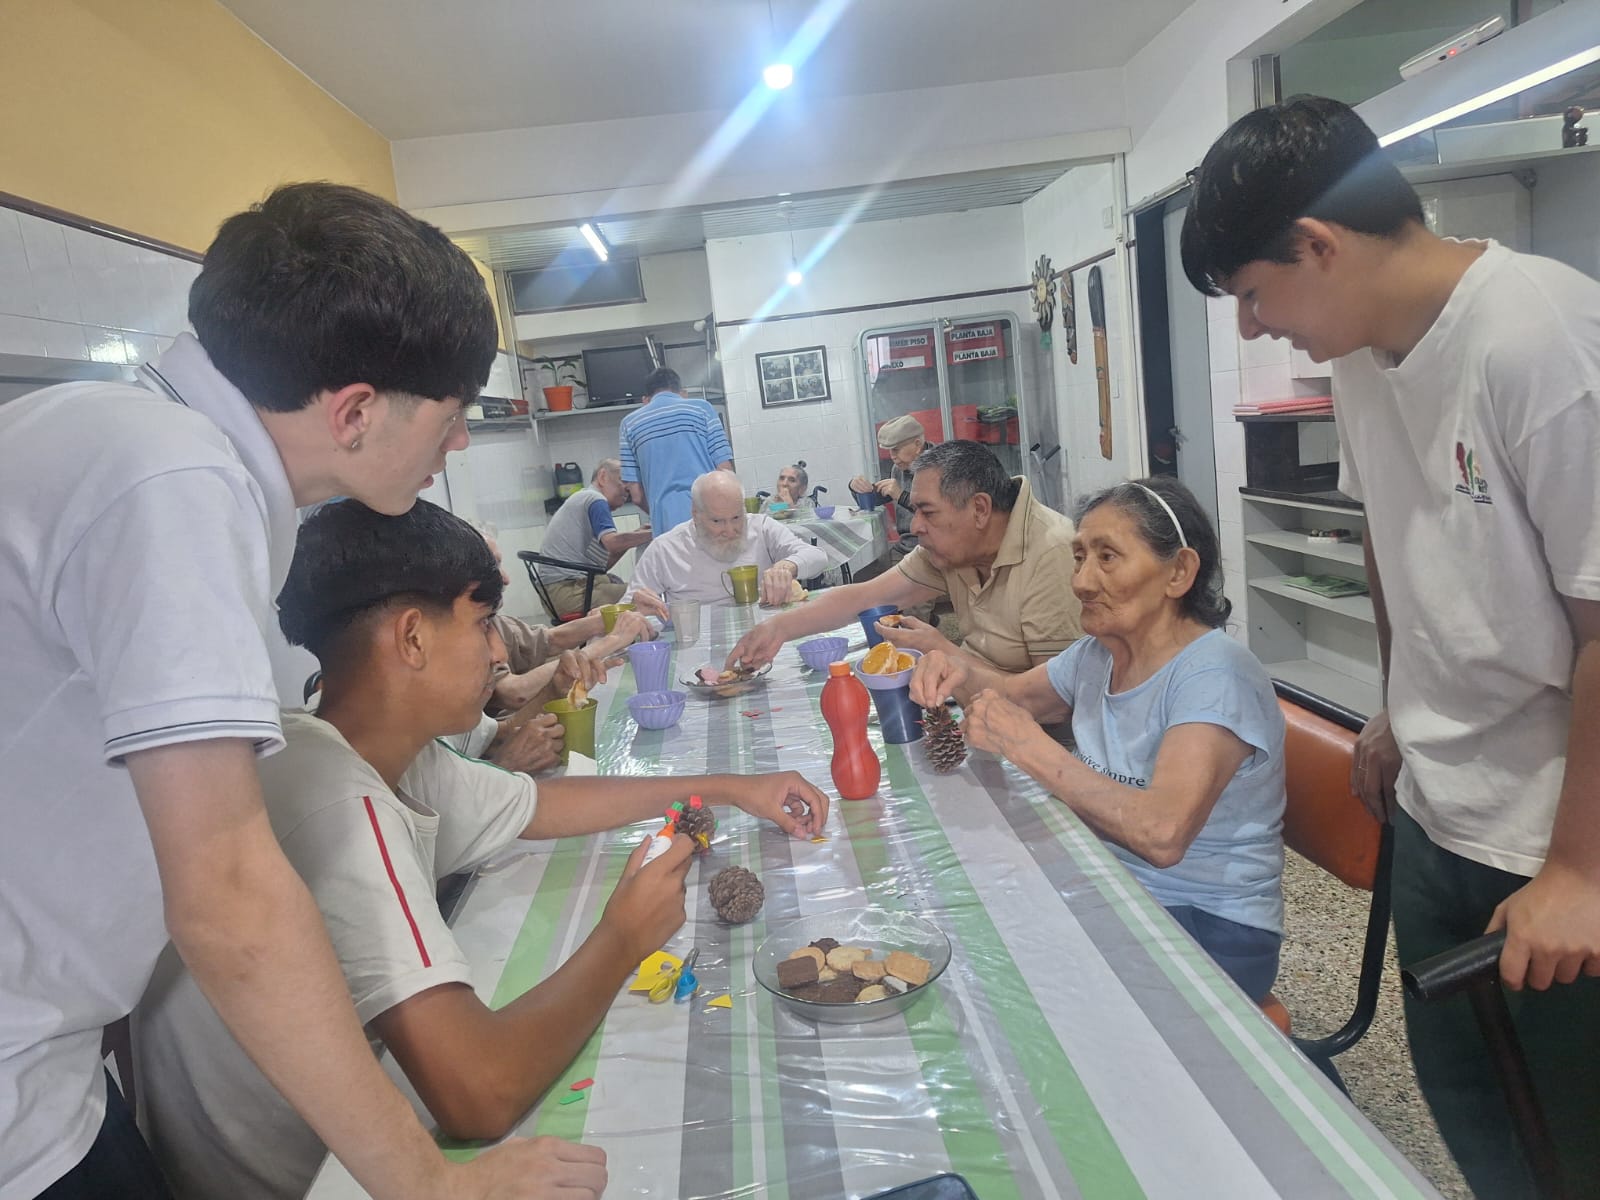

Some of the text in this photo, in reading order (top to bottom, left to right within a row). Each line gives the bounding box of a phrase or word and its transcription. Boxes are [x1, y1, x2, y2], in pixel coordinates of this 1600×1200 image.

[951, 328, 993, 340] PLANTA BAJA
[910, 337, 926, 346] PISO
[954, 348, 997, 361] PLANTA BAJA
